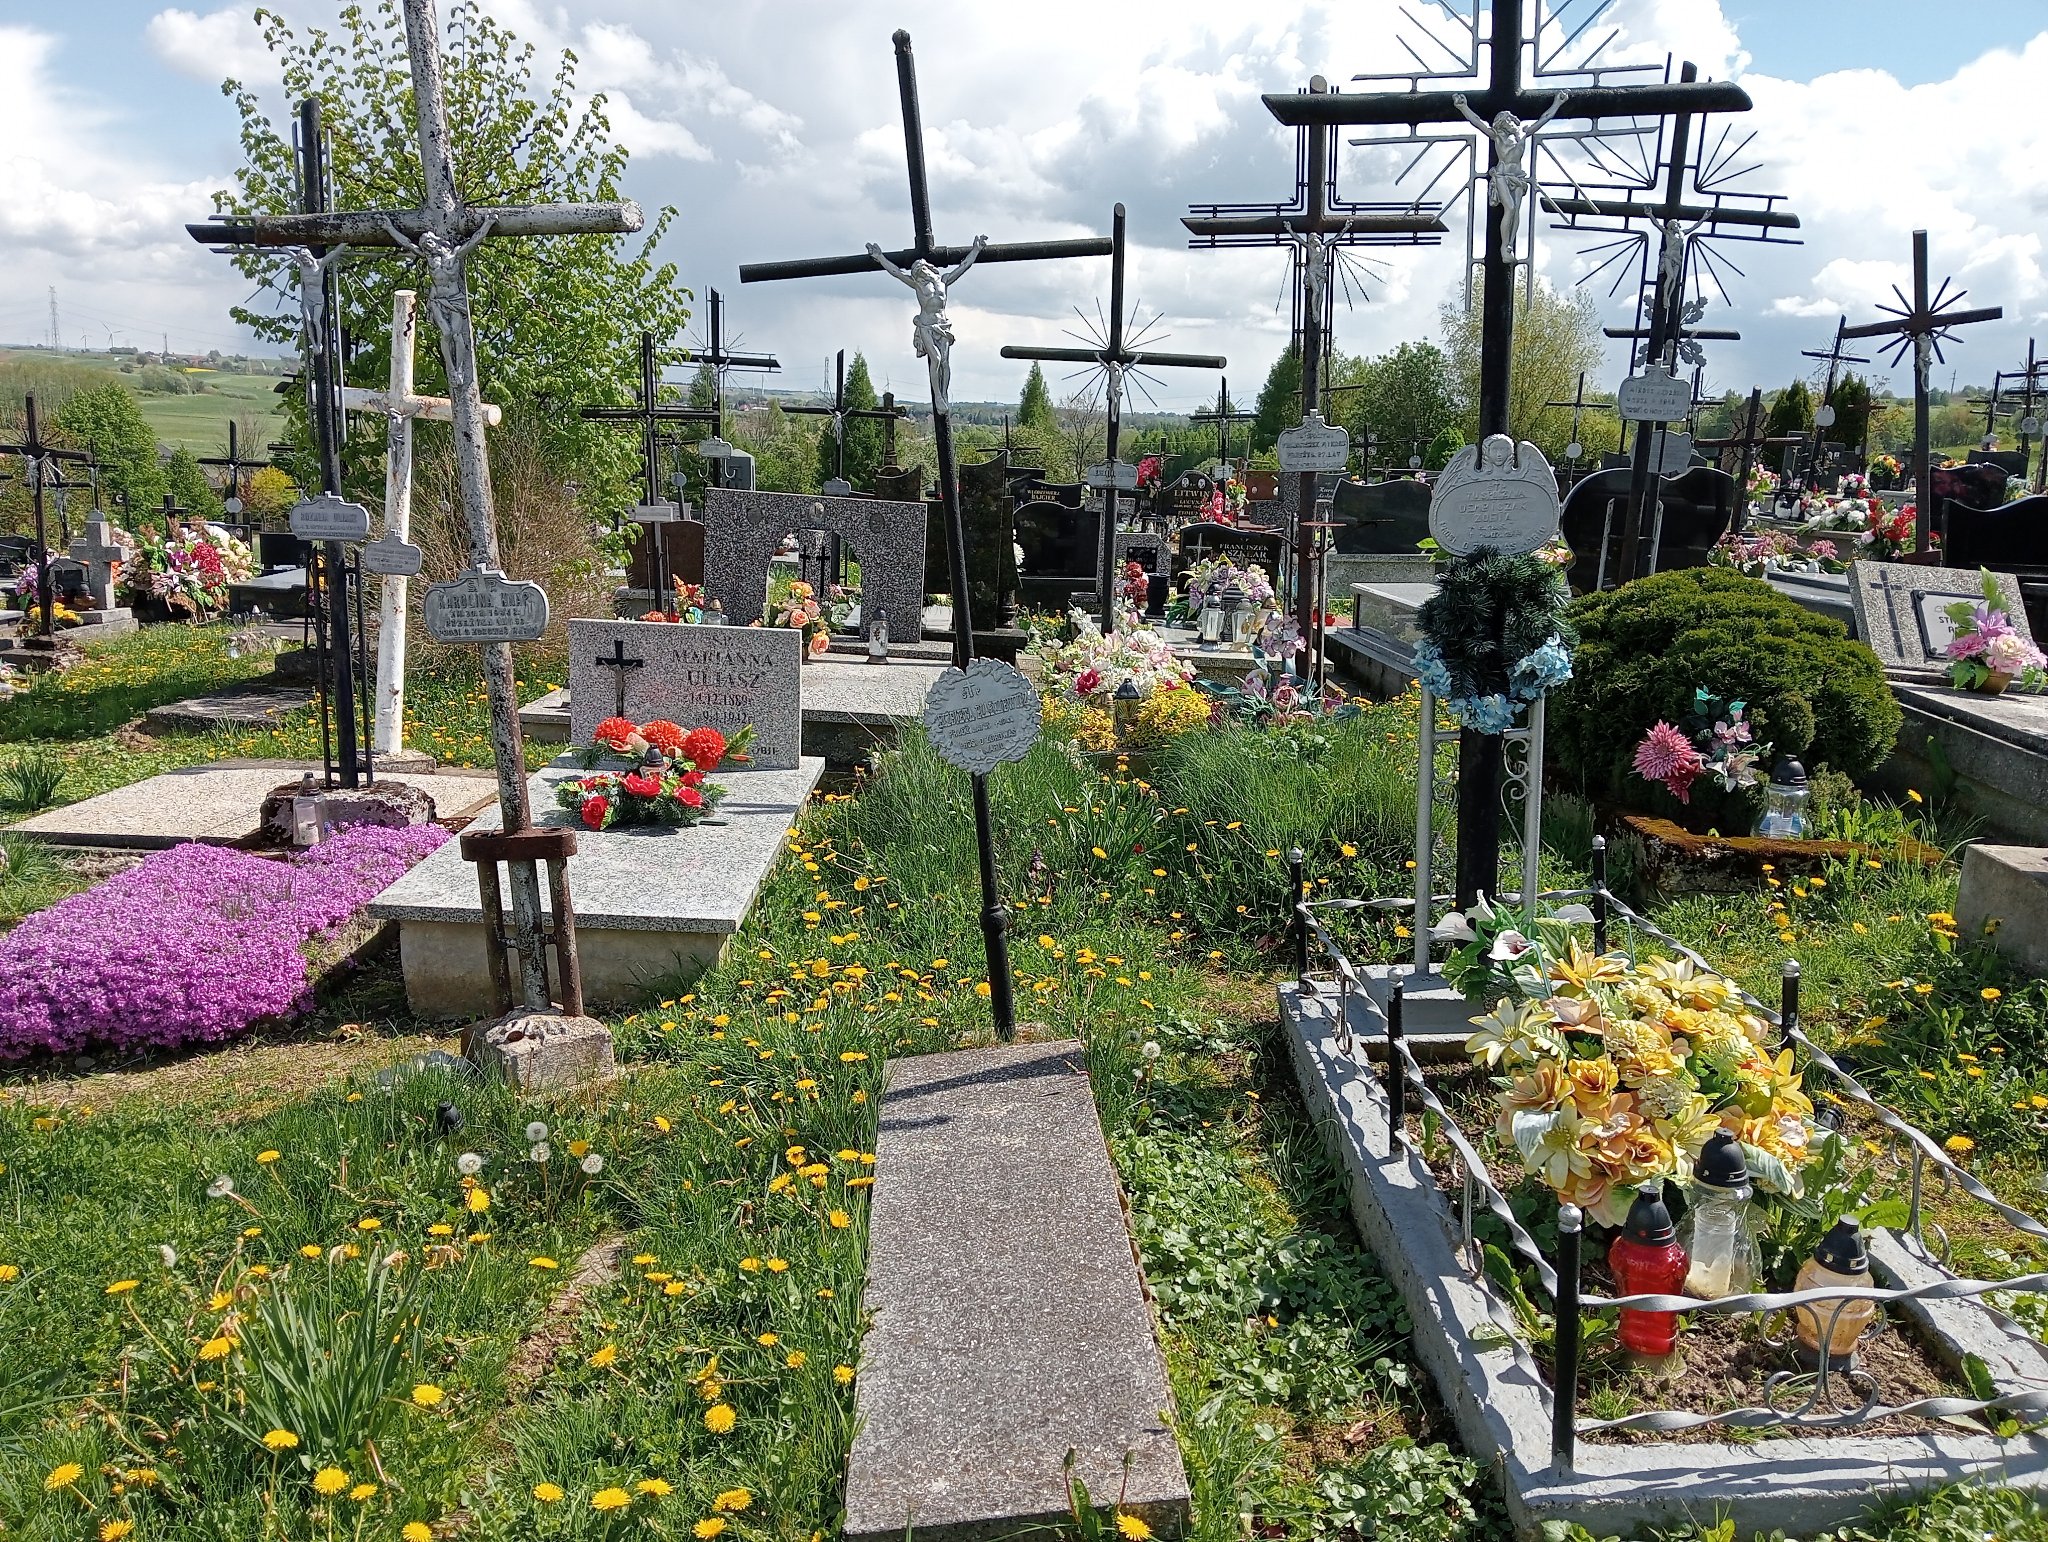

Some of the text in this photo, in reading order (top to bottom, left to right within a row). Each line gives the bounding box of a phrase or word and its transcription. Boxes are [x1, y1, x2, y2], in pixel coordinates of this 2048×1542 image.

[1174, 490, 1211, 498] LITWIN
[1219, 543, 1269, 551] FRANCISZEK
[671, 650, 773, 667] MARIANNA
[687, 670, 761, 689] ULIASZ
